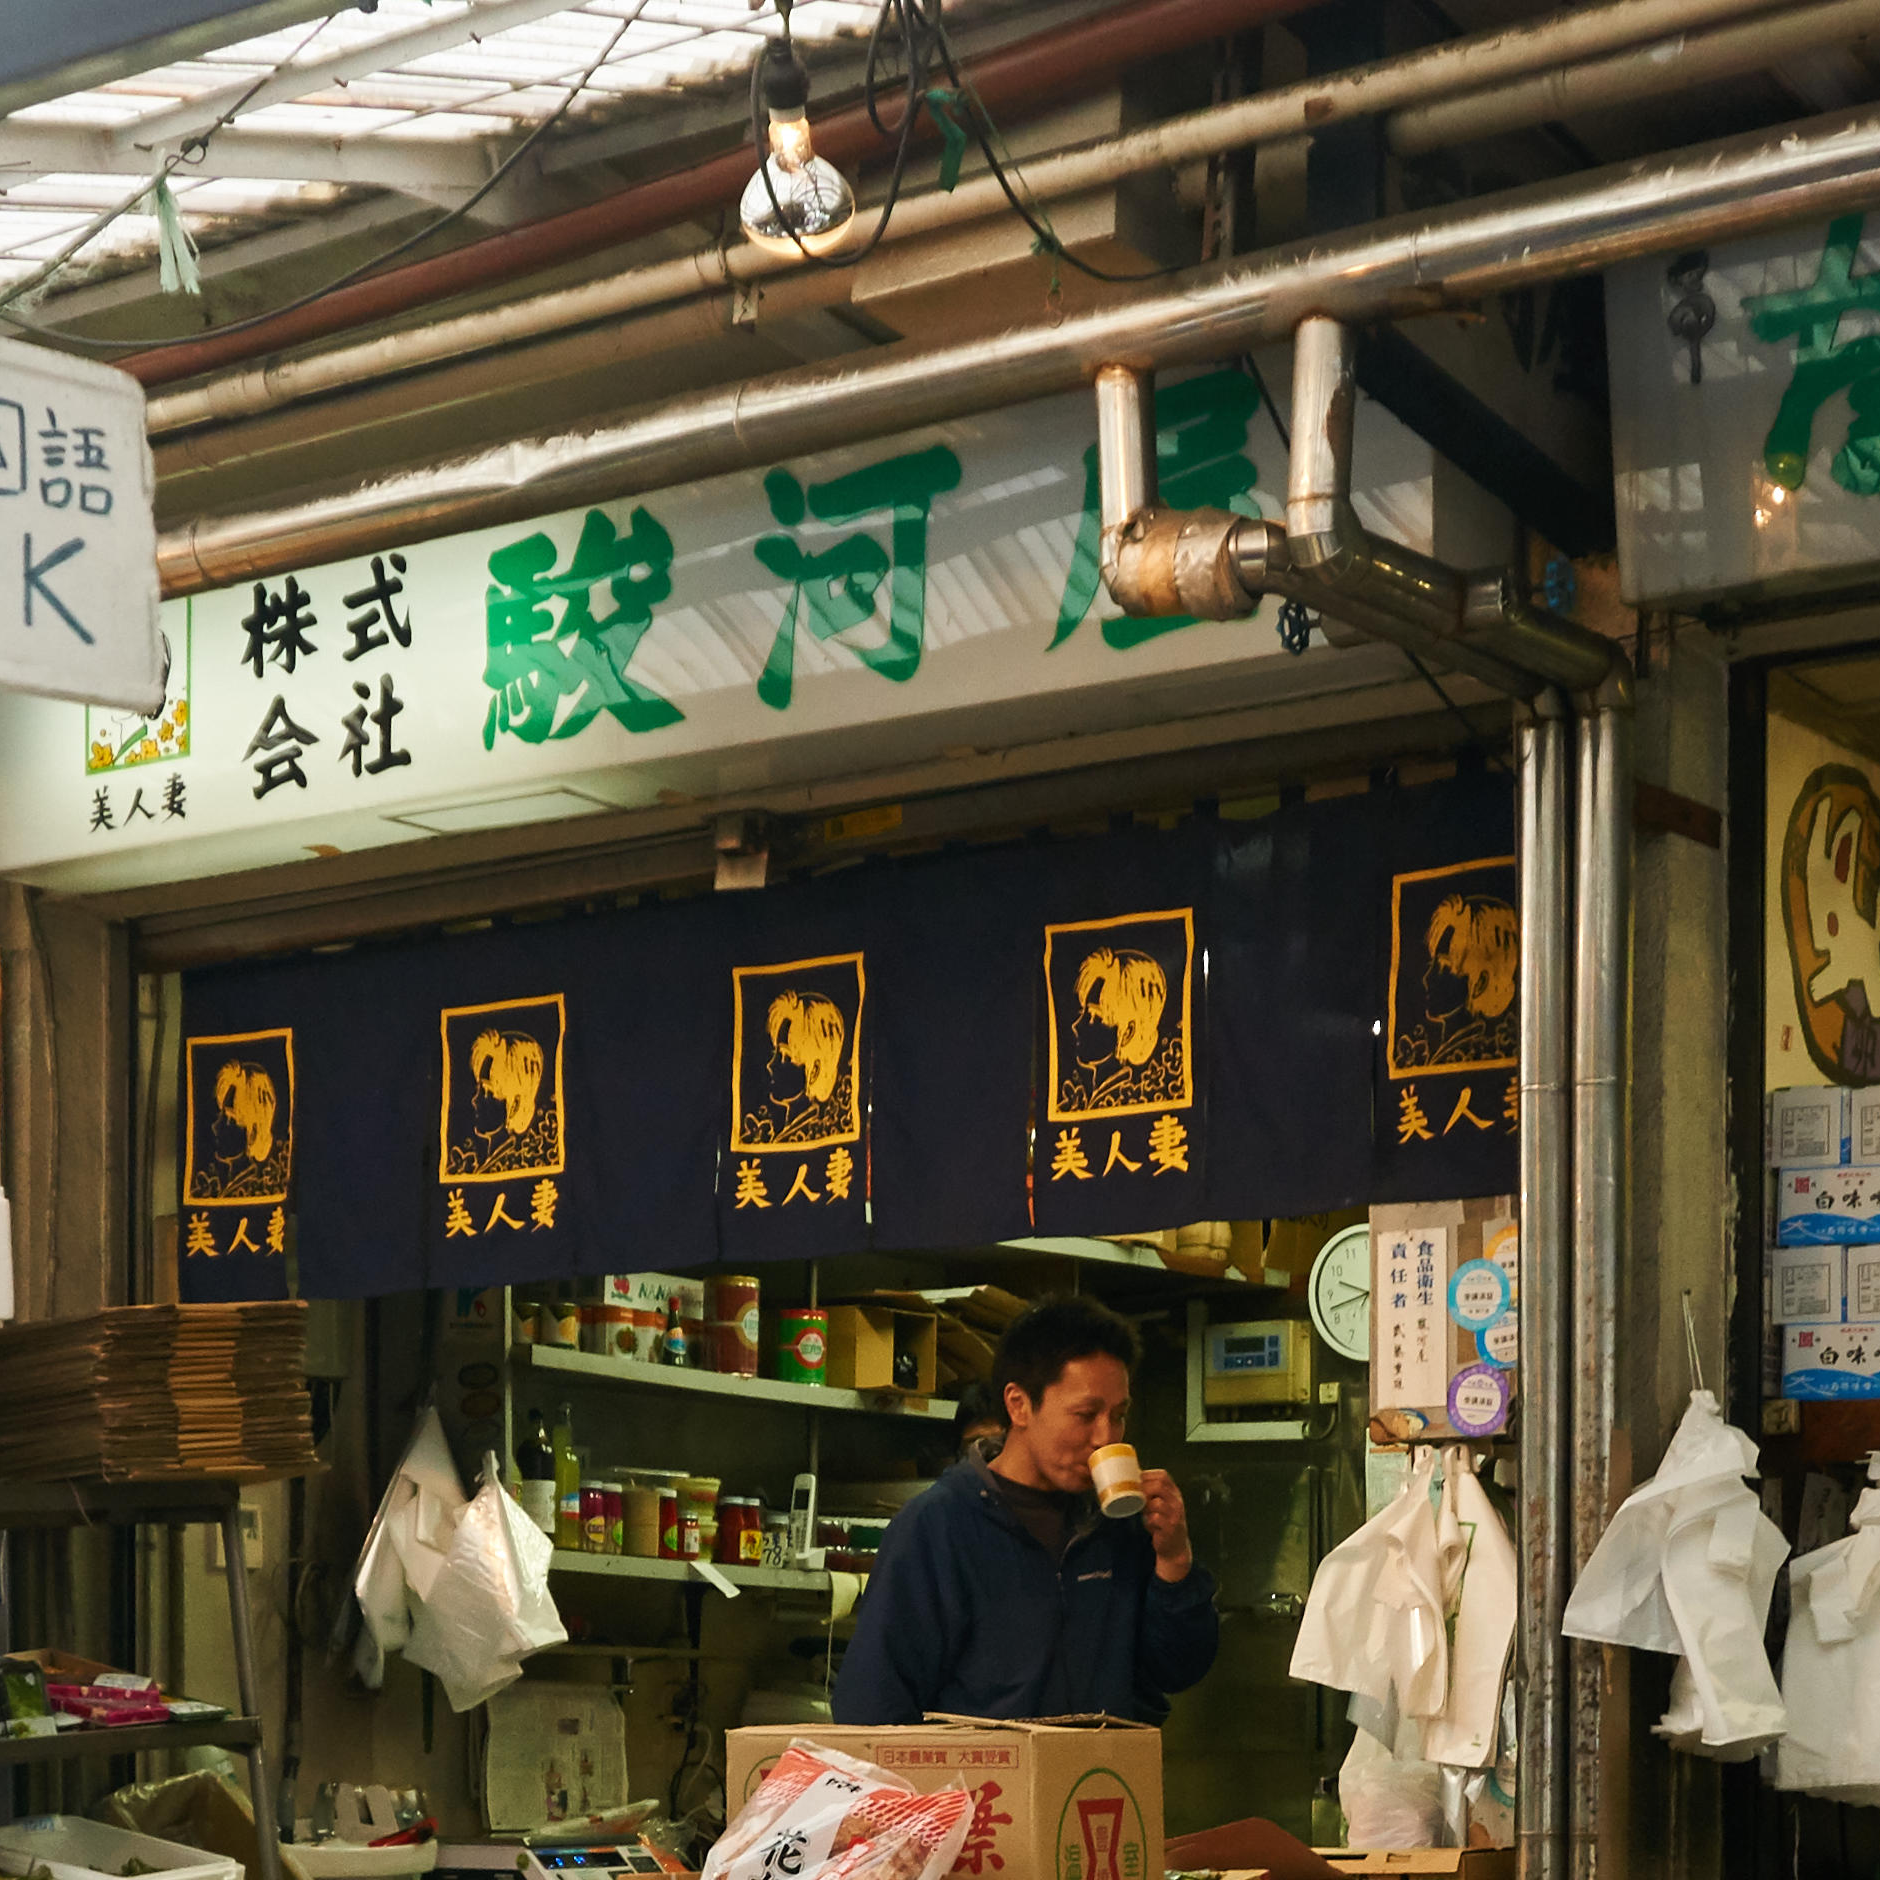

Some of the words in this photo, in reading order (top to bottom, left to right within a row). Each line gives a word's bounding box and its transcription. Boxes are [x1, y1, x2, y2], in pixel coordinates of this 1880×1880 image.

[241, 673, 414, 799] 会社
[88, 771, 188, 834] 美人妻
[733, 1145, 857, 1211] 美人妻
[1049, 1112, 1191, 1183] 美人妻
[444, 1178, 558, 1240] 美人妻
